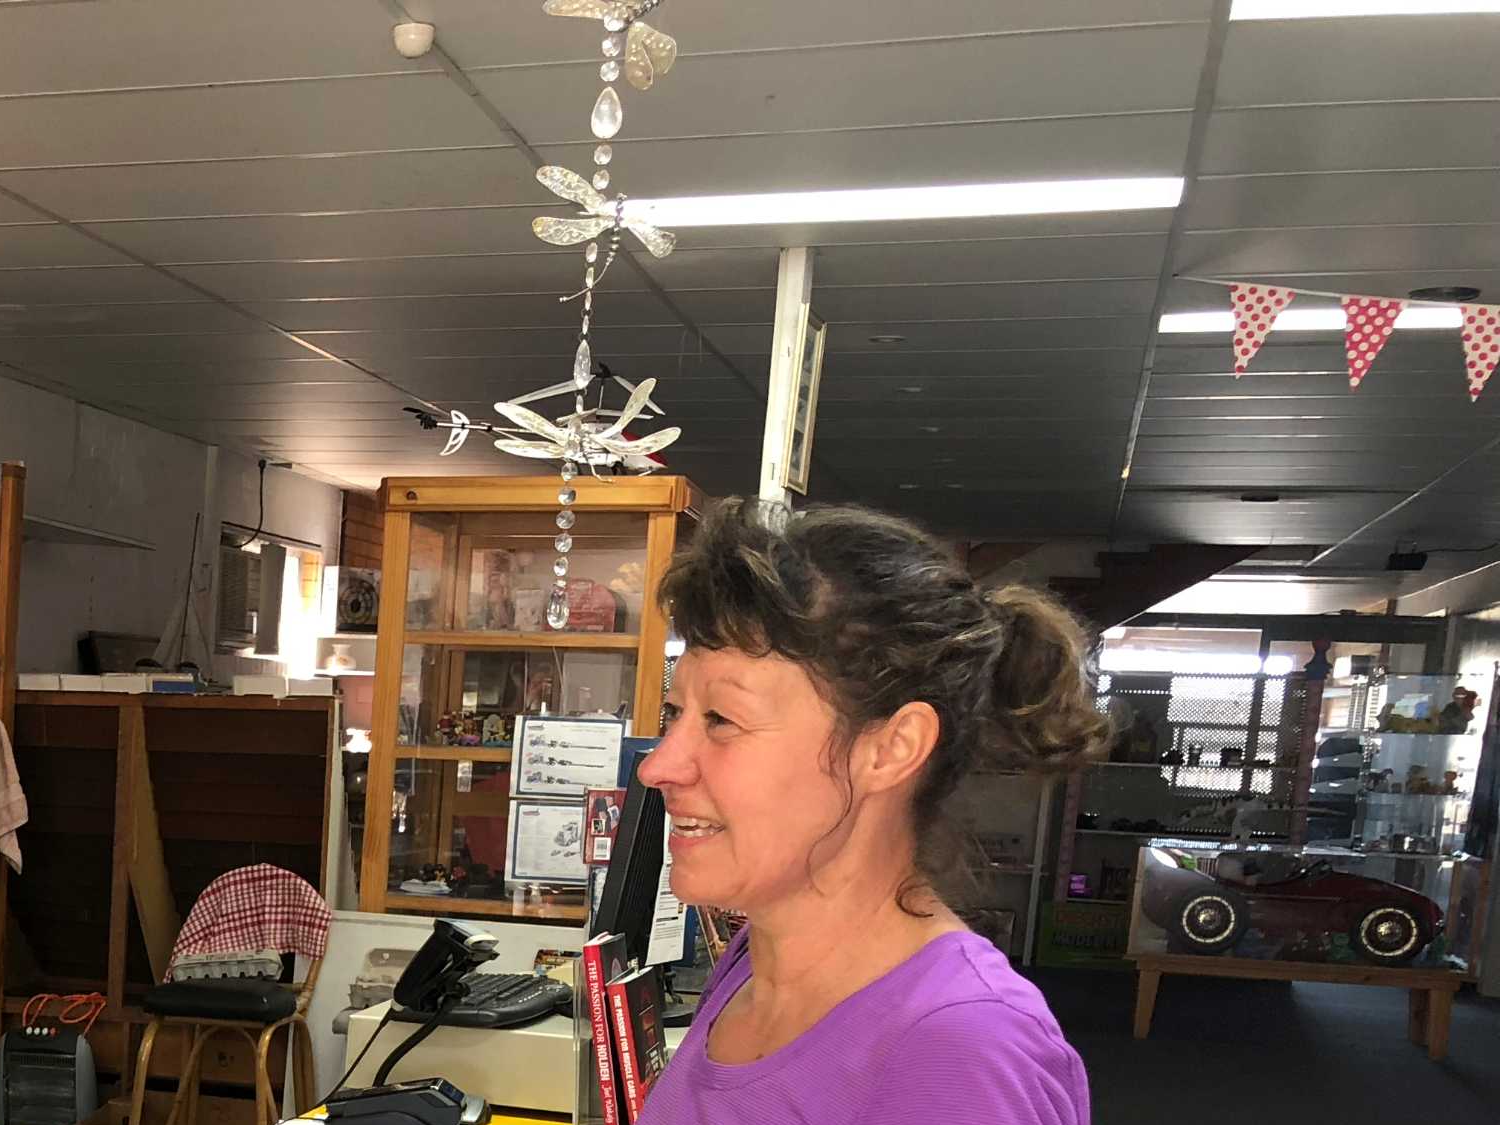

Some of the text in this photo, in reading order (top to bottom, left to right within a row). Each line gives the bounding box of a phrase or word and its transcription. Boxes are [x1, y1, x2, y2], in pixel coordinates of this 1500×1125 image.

[587, 960, 597, 982] THE
[589, 982, 603, 1022] PASSION
[613, 994, 622, 1008] THE
[594, 1023, 605, 1043] FOR
[615, 1008, 627, 1037] PASSION
[620, 1037, 629, 1051] FOR
[597, 1044, 610, 1081] HOLDEN
[623, 1052, 633, 1080] MUSCLE
[627, 1080, 637, 1098] CARS
